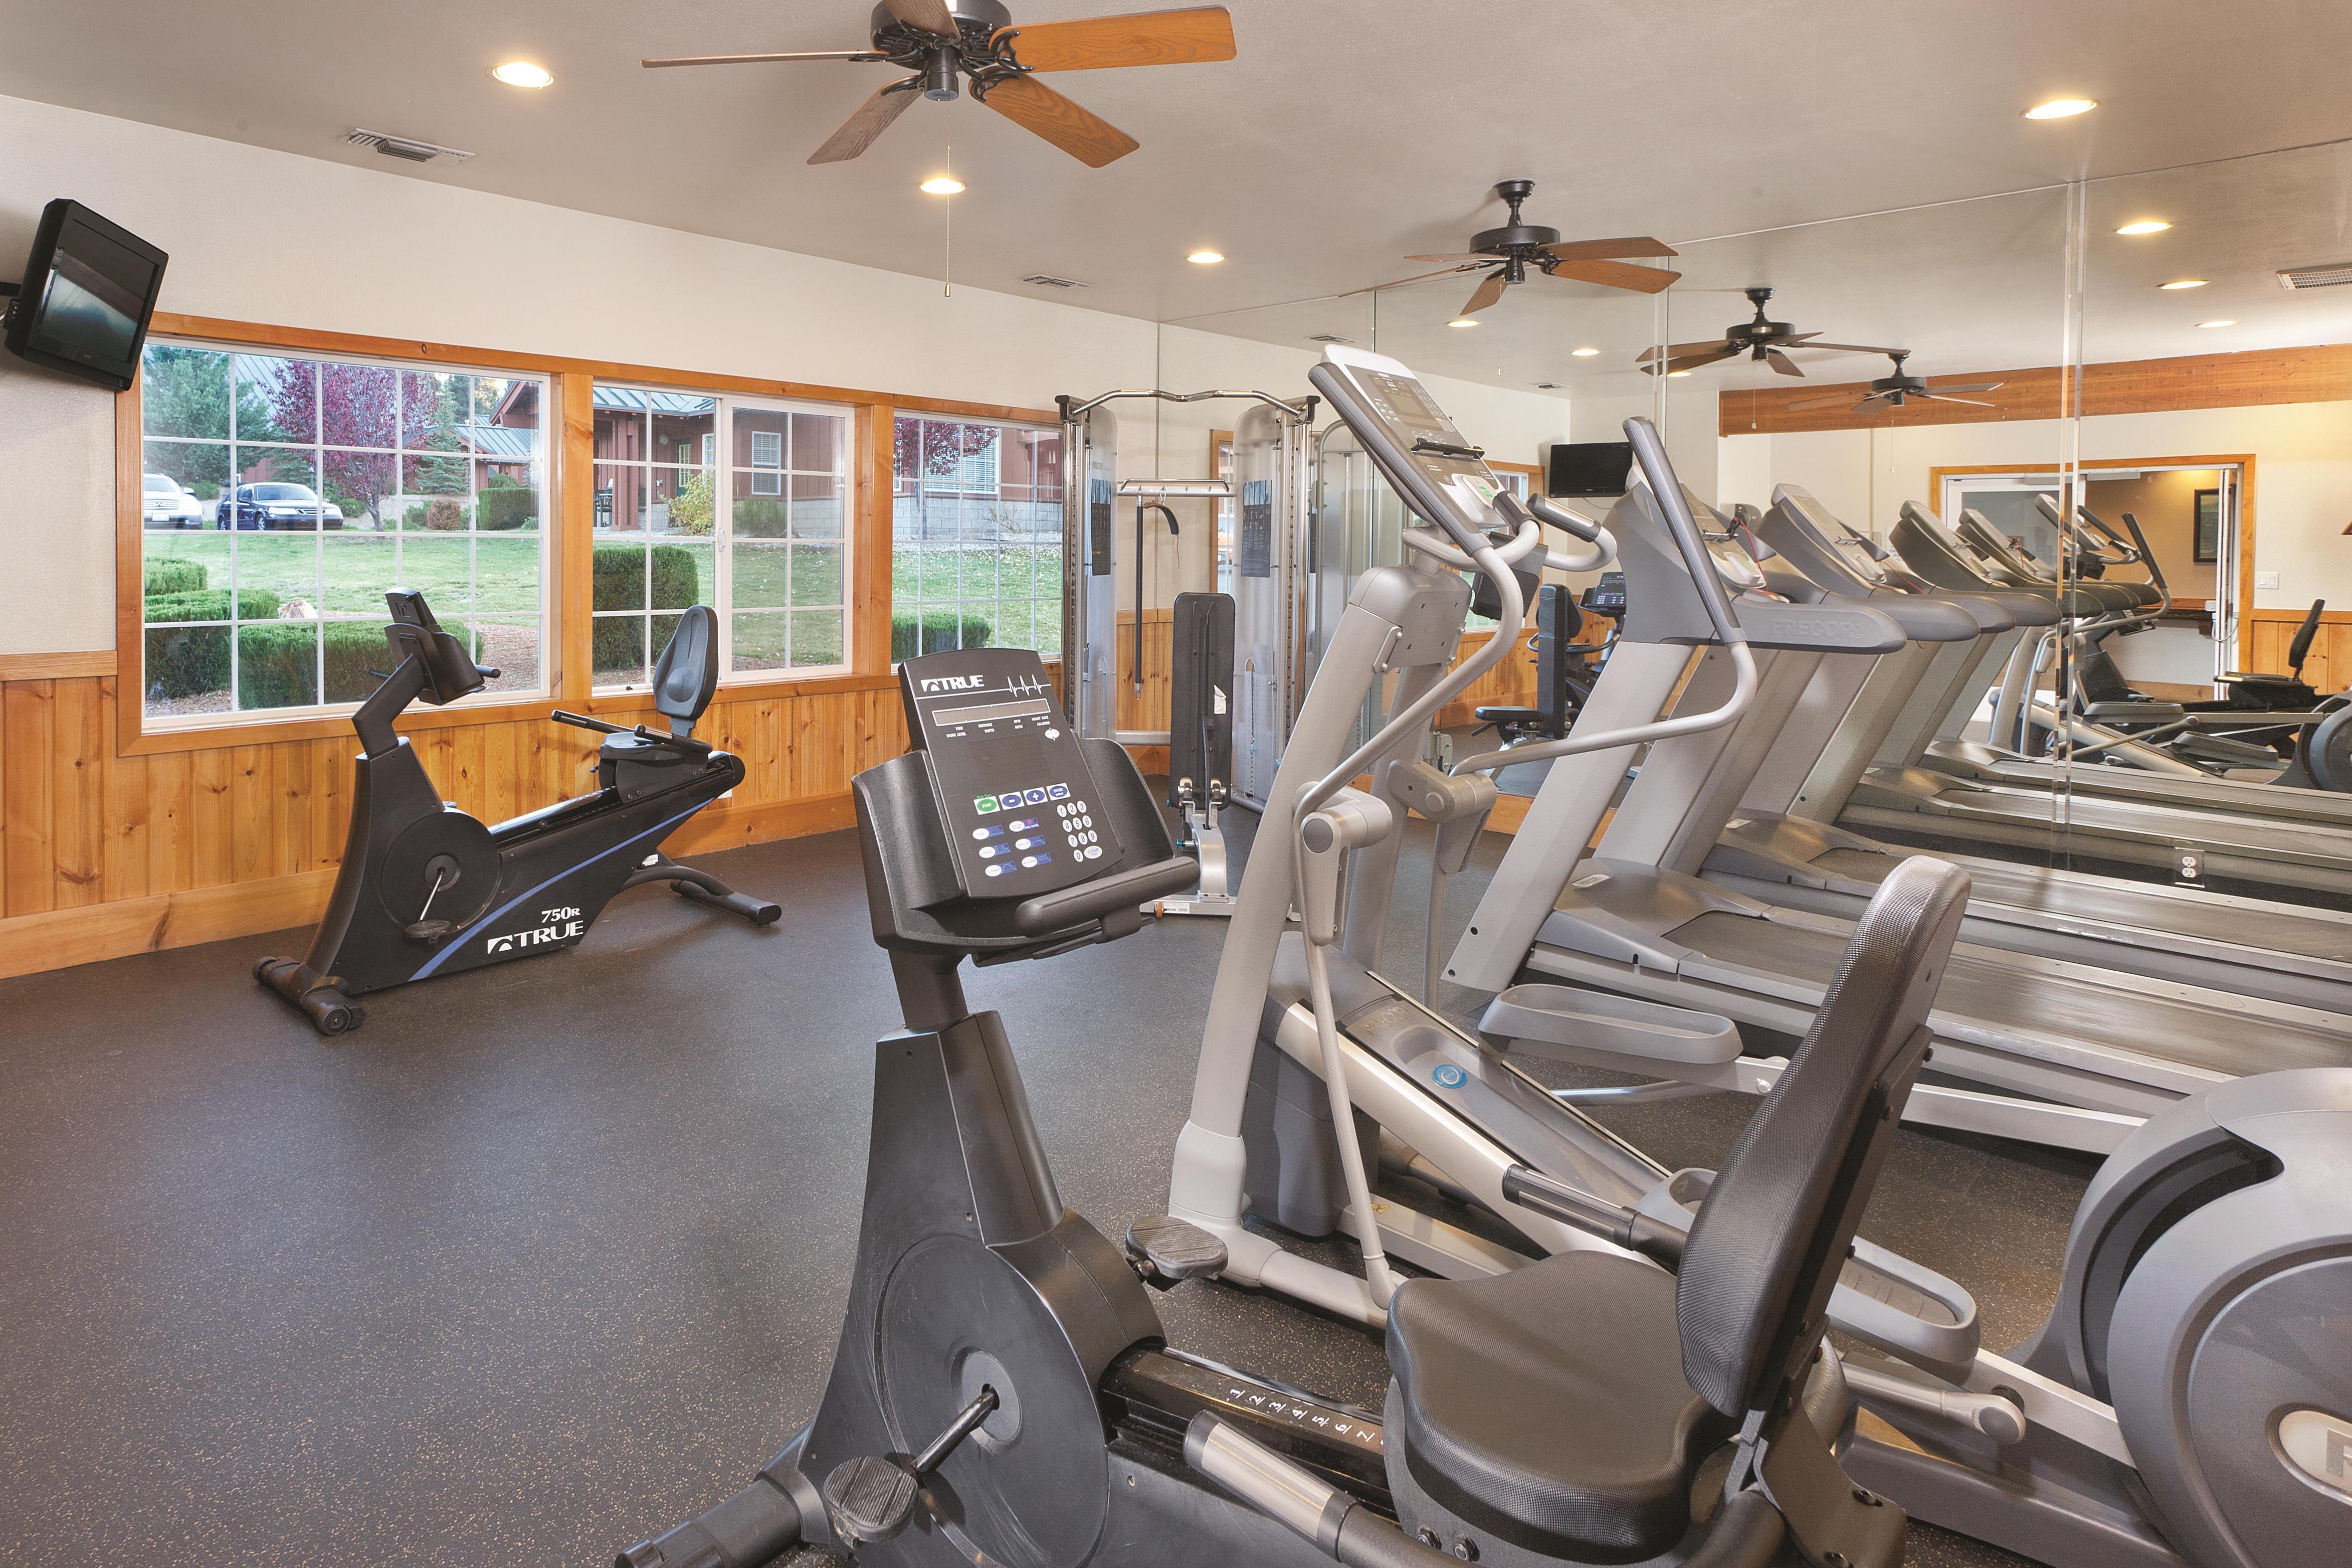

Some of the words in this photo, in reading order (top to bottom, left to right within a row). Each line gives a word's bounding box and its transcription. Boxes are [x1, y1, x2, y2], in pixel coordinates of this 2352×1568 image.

[1771, 619, 1853, 639] PRECOR
[937, 675, 984, 691] TRUE
[541, 907, 581, 923] 750R
[514, 920, 584, 947] TRUE
